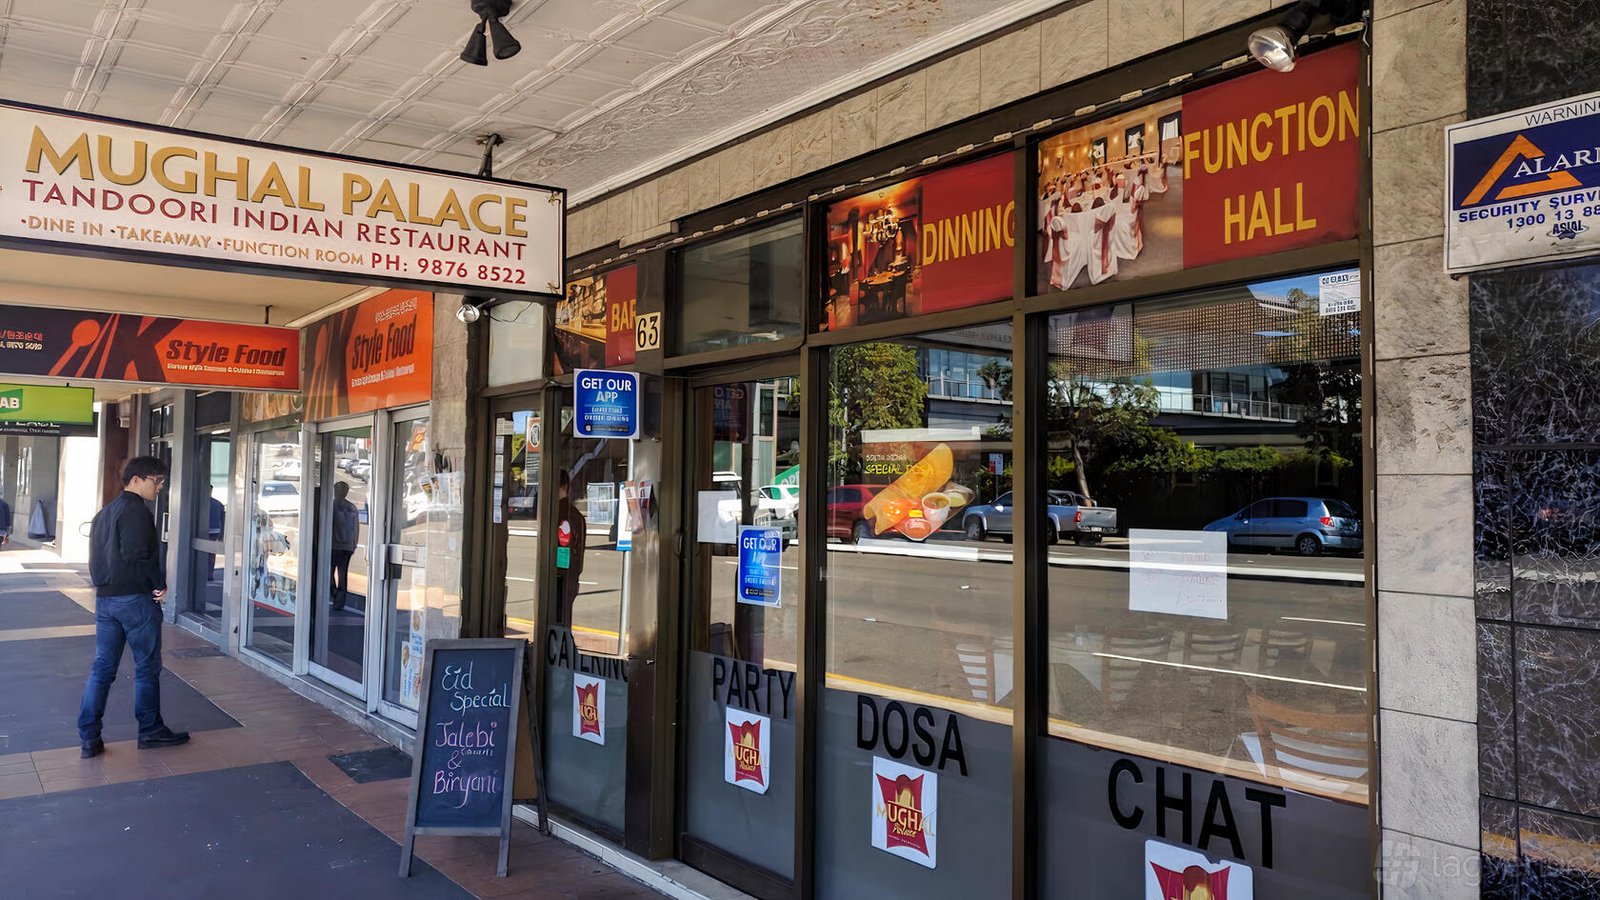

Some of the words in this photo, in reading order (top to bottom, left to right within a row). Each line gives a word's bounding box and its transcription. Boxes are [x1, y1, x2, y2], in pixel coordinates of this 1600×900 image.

[1525, 99, 1600, 127] WARNIN
[1183, 87, 1359, 180] FUNCTION
[25, 125, 325, 212] MUGHAL
[342, 172, 528, 238] PALACE
[22, 179, 217, 224] TANDOORI
[233, 206, 343, 239] INDIAN
[357, 222, 527, 260] RESTAURANT
[1224, 182, 1317, 245] HALL
[1458, 200, 1541, 223] SECURITY
[1549, 190, 1600, 209] SURV
[1507, 214, 1545, 229] 1300
[1554, 210, 1574, 221] 13
[27, 215, 75, 233] DINE
[83, 221, 103, 237] IN
[117, 225, 212, 249] TAKEAWAY
[222, 238, 309, 258] FUNCTION
[315, 248, 364, 265] ROOM
[371, 253, 408, 272] PH:
[417, 258, 468, 278] 9876
[478, 264, 526, 285] 8522
[352, 329, 384, 373] Style
[385, 314, 417, 362] Food
[637, 316, 659, 348] 63
[166, 339, 230, 365] Style
[234, 344, 288, 367] Food
[581, 377, 604, 390] GET
[606, 378, 632, 392] OUR
[596, 391, 618, 403] APP
[743, 537, 758, 550] GET
[441, 661, 474, 692] Eid
[712, 657, 796, 720] PARTY
[450, 683, 512, 717] Special
[435, 720, 498, 749] Jalebi
[857, 694, 968, 777] DOSA
[447, 749, 464, 770] &
[433, 770, 497, 809] Biryani
[1108, 758, 1287, 870] CHAT
